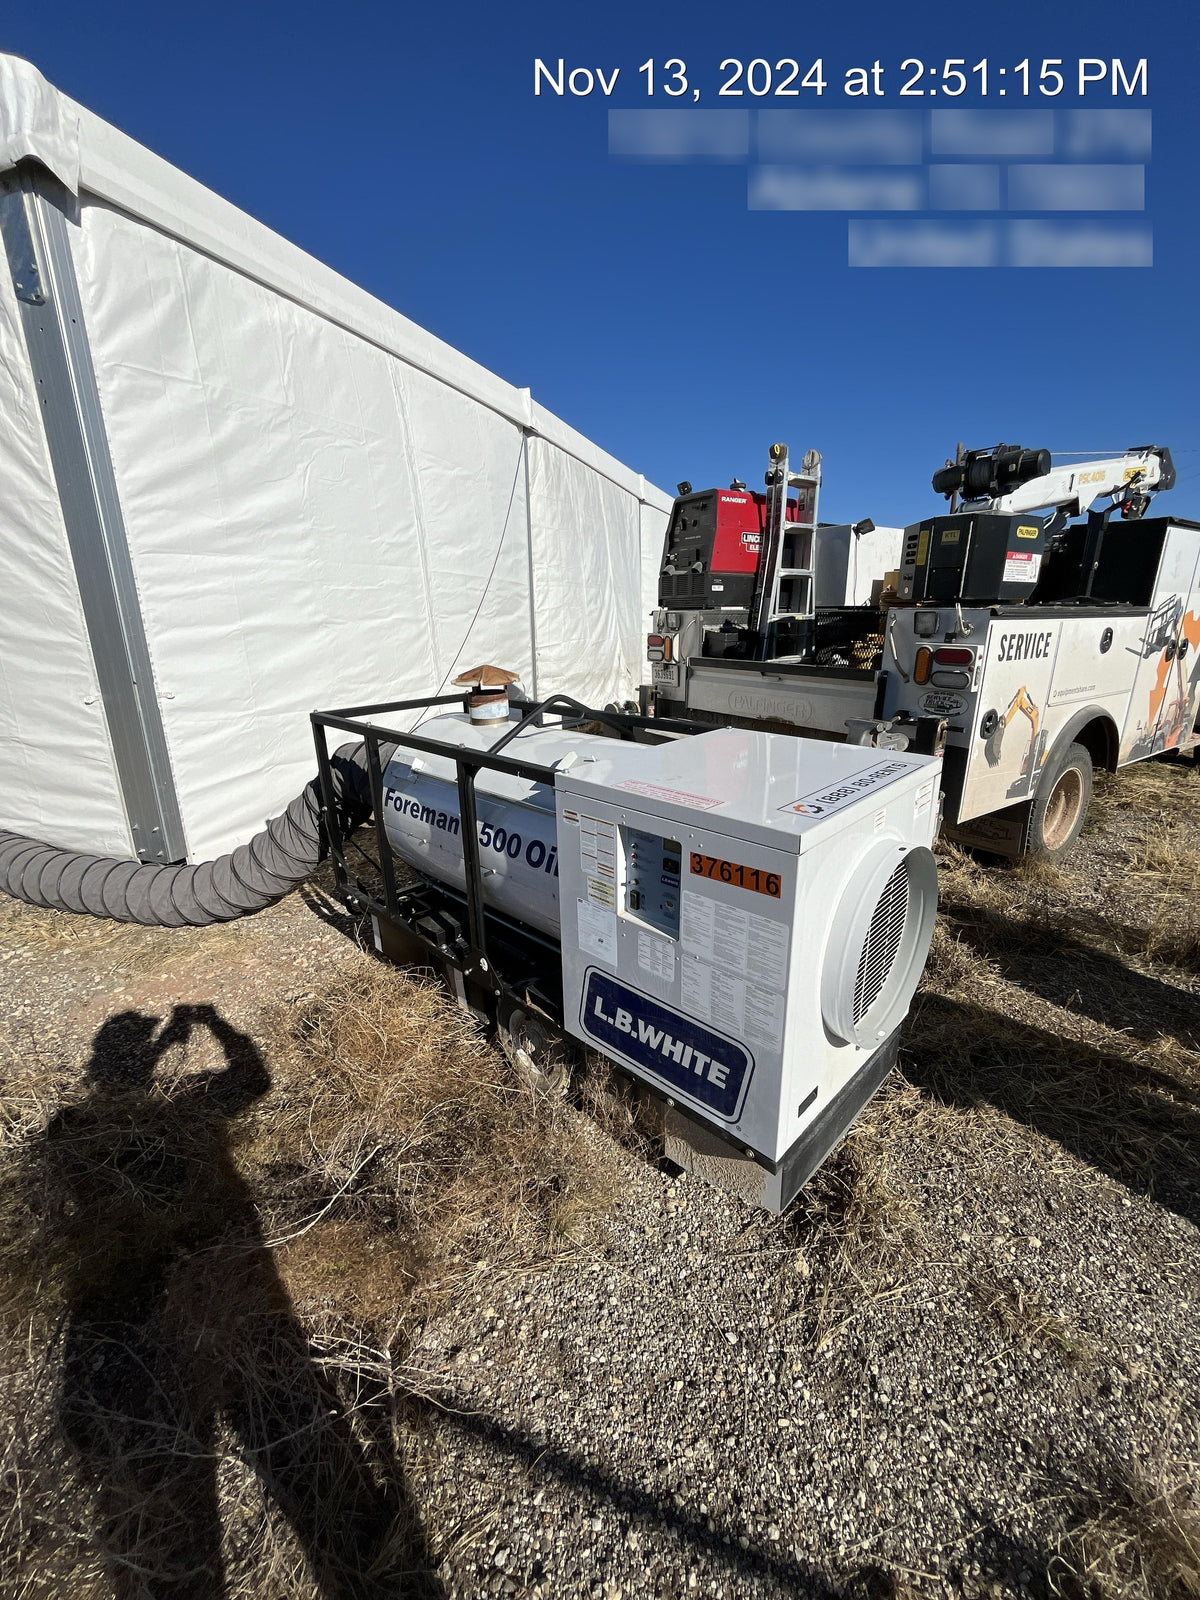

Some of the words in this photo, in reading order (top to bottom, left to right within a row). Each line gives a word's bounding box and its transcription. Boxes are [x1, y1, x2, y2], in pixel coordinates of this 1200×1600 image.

[720, 495, 748, 505] RANGER
[742, 533, 763, 544] LINC
[1017, 527, 1039, 538] PALFINGER
[998, 632, 1053, 662] SERVICE
[734, 695, 808, 719] PALFINGER
[815, 785, 861, 805] (888)
[851, 762, 908, 788] 80-RENTS
[384, 787, 460, 836] Foreman
[478, 822, 522, 859] 500
[525, 839, 559, 878] Oi
[691, 852, 780, 897] 376116
[593, 995, 731, 1090] L.B.WHITE
